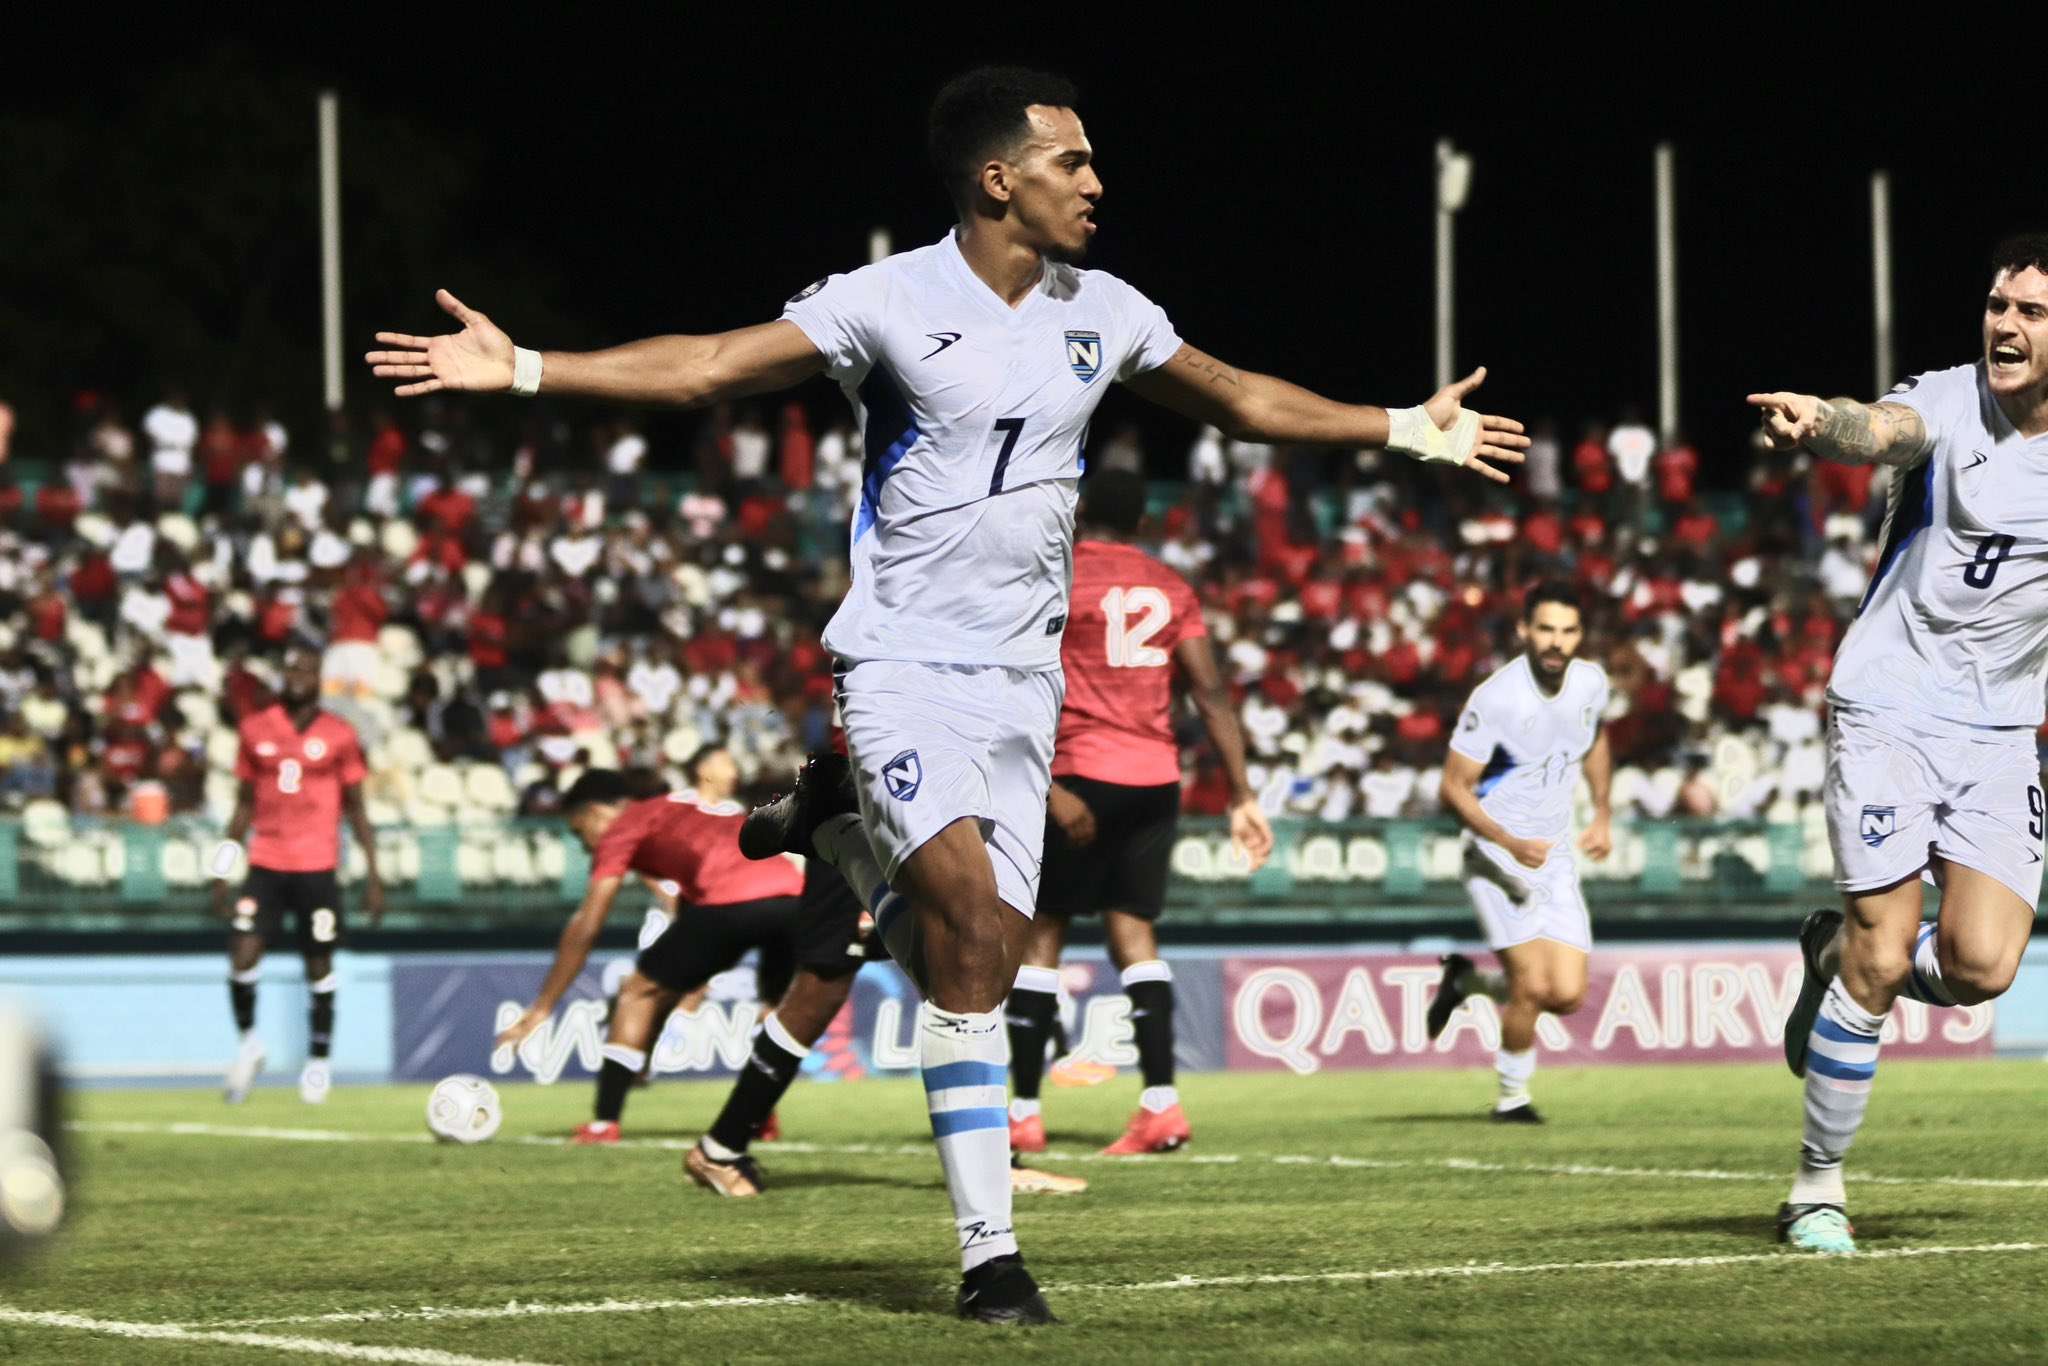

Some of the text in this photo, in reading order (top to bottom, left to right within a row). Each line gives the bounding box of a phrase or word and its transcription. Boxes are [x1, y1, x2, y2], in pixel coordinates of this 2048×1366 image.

[1068, 341, 1098, 371] N
[988, 417, 1026, 497] 7
[1099, 586, 1171, 667] 12
[886, 757, 919, 793] N
[1861, 813, 1894, 837] N
[2027, 785, 2044, 841] 9
